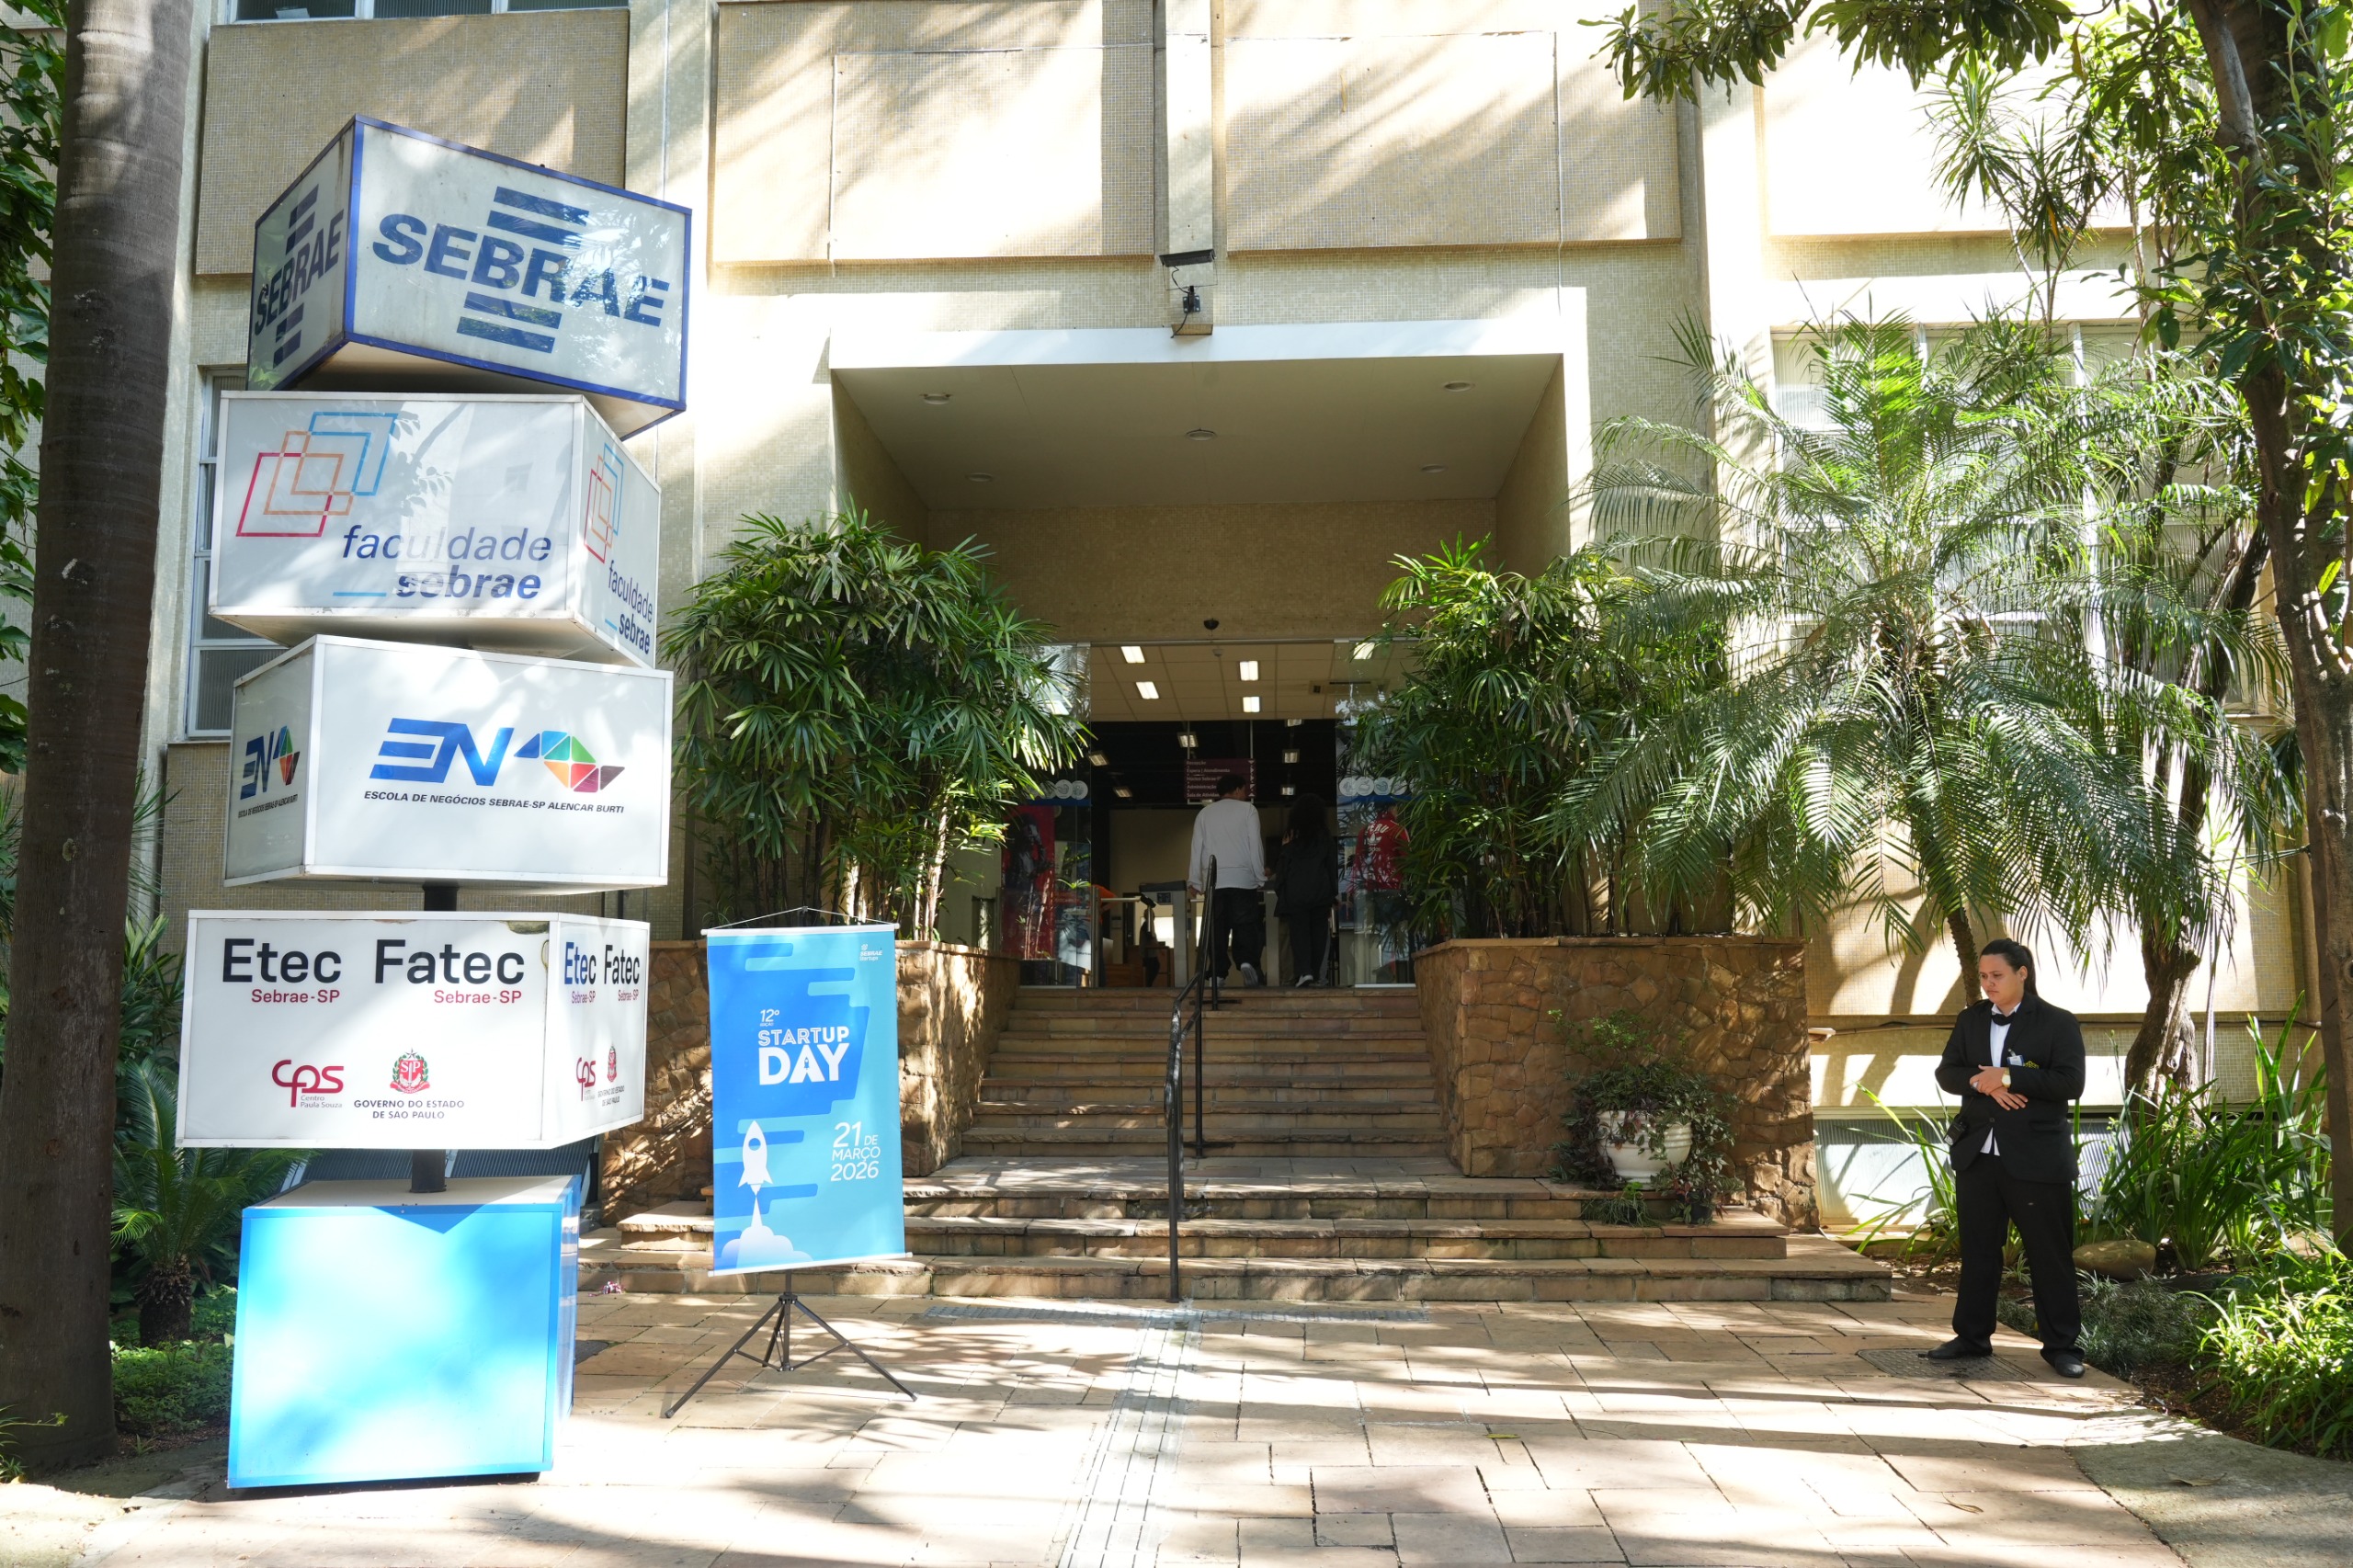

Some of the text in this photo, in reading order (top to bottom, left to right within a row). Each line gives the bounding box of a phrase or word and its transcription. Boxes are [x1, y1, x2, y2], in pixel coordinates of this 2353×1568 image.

[255, 209, 344, 335] SEBRAE
[372, 213, 670, 327] SEBRAE
[342, 524, 551, 562] faculdade
[395, 565, 541, 598] sebrae
[608, 559, 653, 623] faculdade
[619, 613, 650, 654] sebrae
[364, 790, 624, 813] ESCOLA DE NEGÓCIOS SEBRAE-SP ALENCAR BURTI
[222, 938, 525, 984] Etec Fatec
[564, 941, 640, 984] Etec Fatec
[758, 1026, 849, 1046] STARTUP
[758, 1042, 850, 1085] DAY
[354, 1099, 465, 1108] GOVERNO DO ESTADO
[372, 1110, 385, 1119] DE
[413, 1110, 445, 1119] PAULO
[833, 1121, 879, 1148] 21 DE
[830, 1160, 880, 1182] 2026
[831, 1146, 881, 1162] MARÇO
